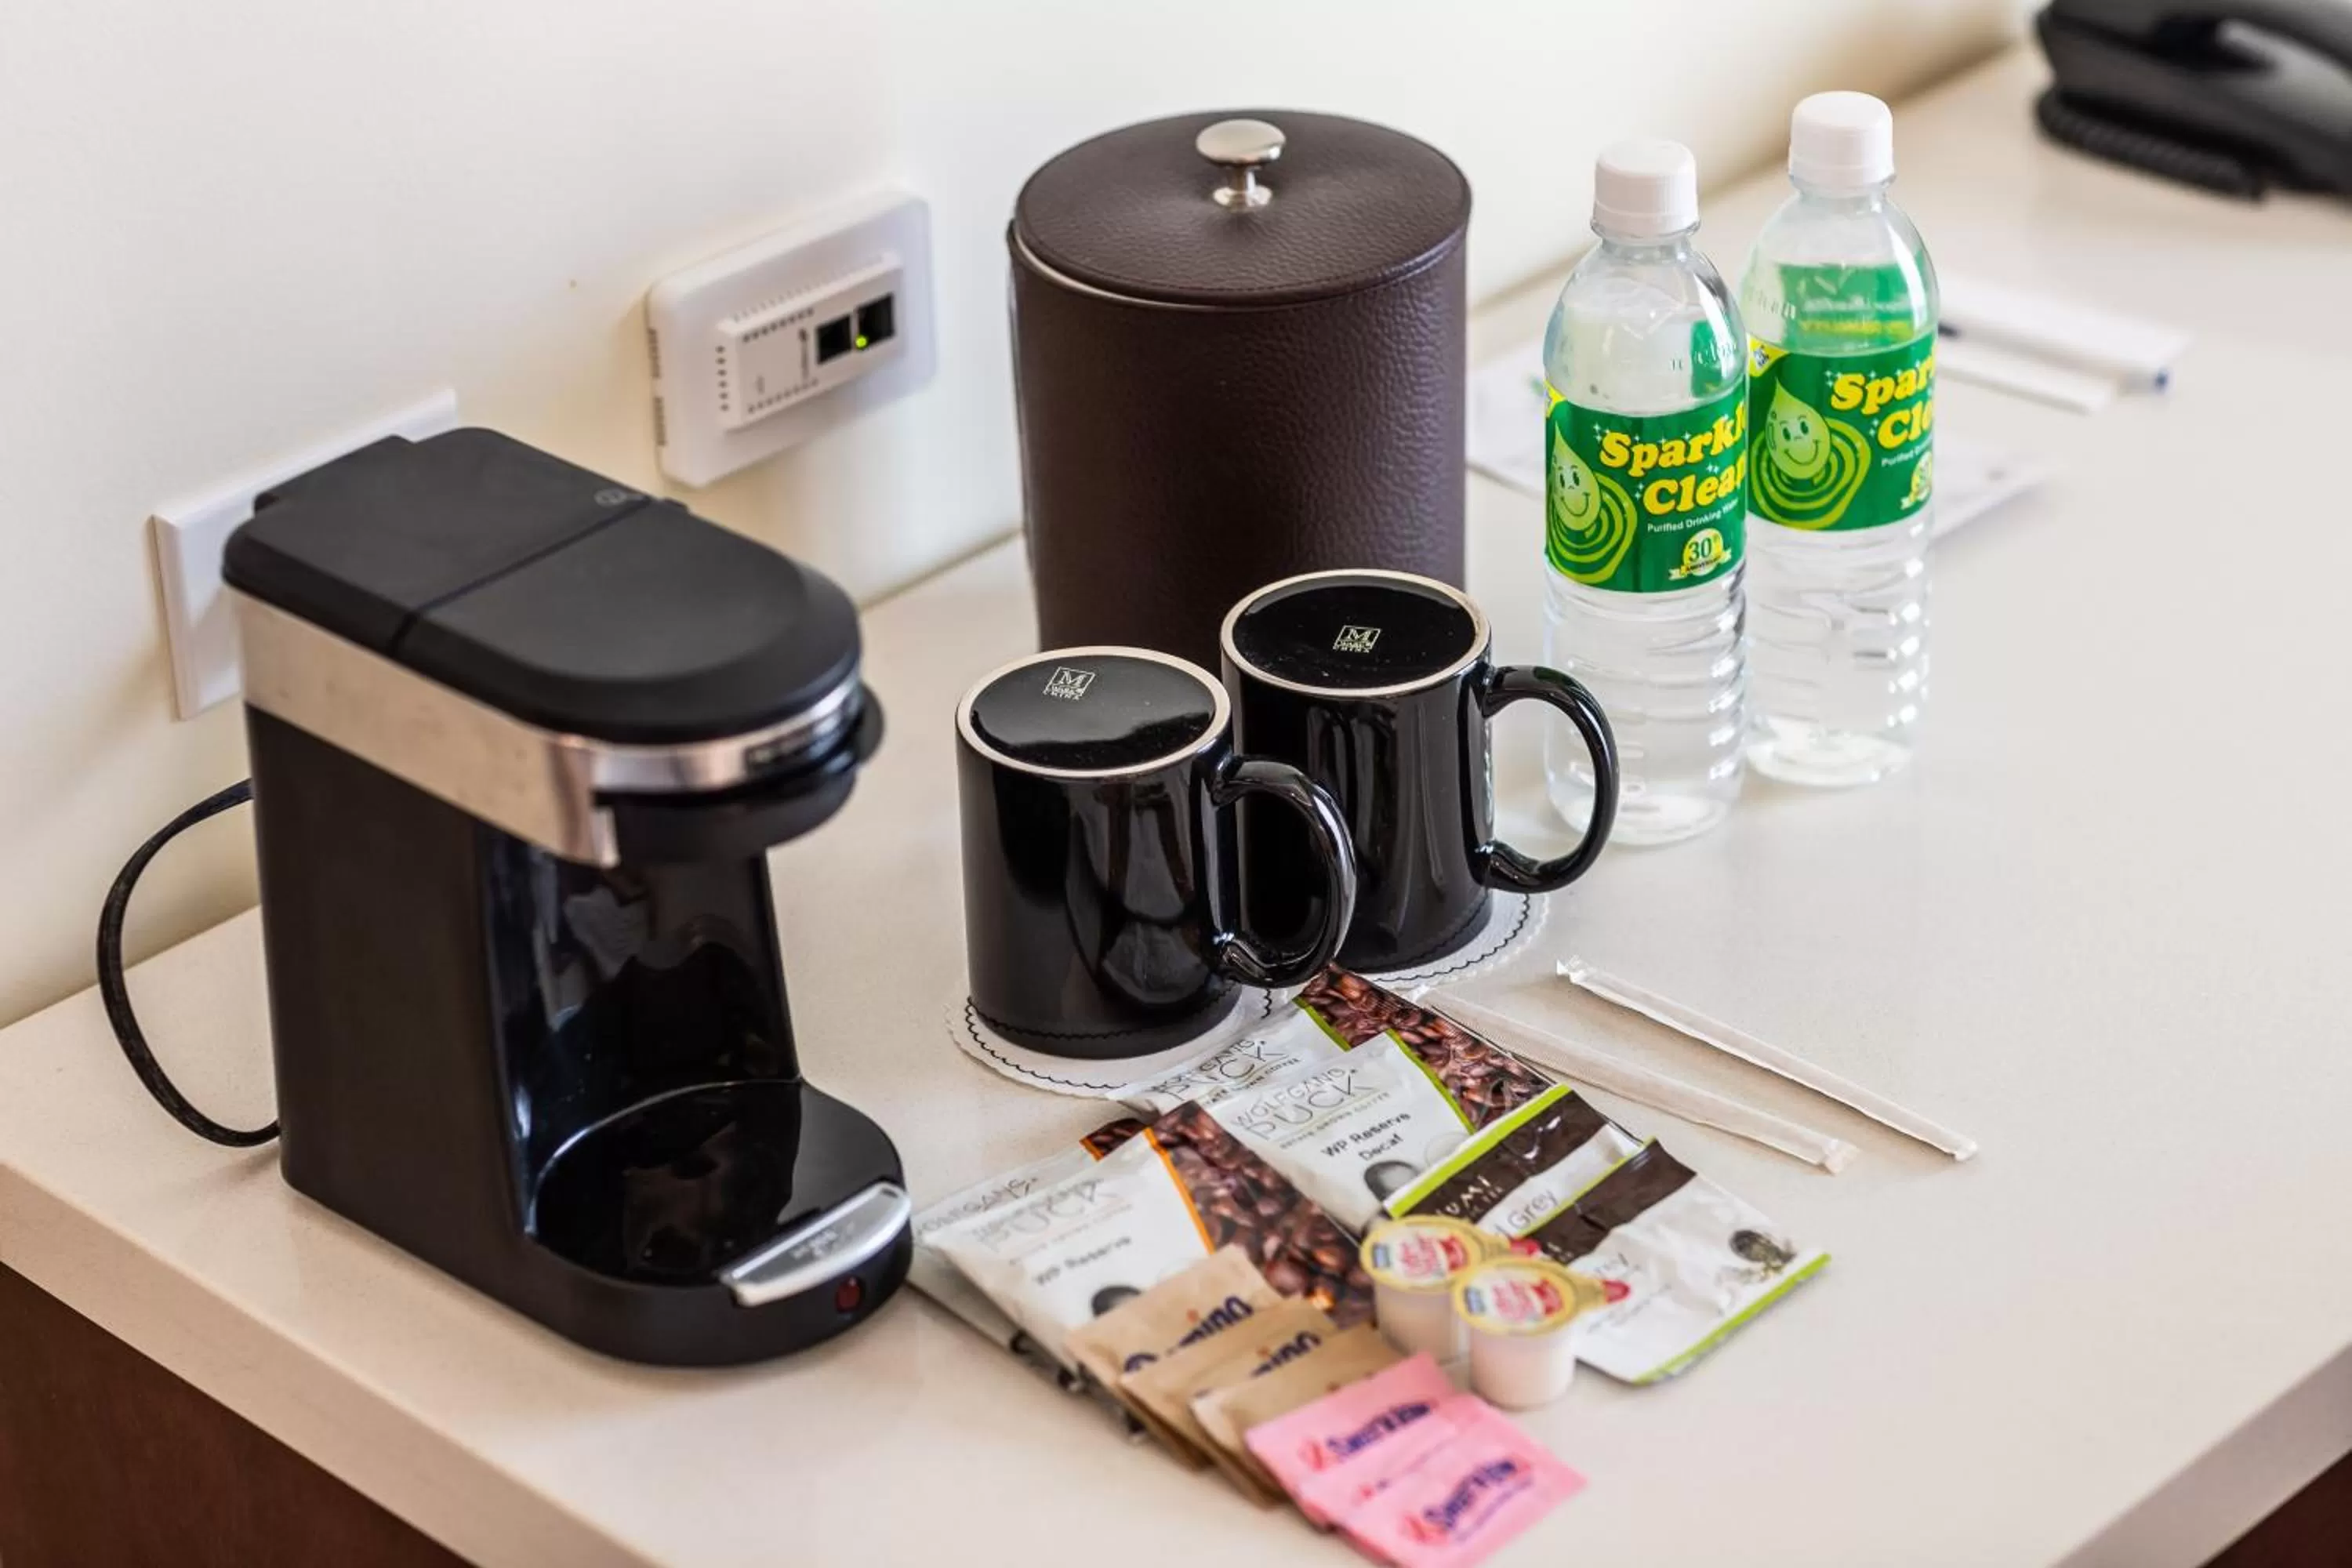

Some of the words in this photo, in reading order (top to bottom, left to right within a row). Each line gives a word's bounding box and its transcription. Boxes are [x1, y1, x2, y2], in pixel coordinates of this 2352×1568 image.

[1647, 519, 1684, 532] Purified
[1232, 1067, 1345, 1127] WOLFGANG
[1243, 1074, 1377, 1142] PUCK
[1321, 1138, 1348, 1157] WP
[1348, 1112, 1411, 1144] Reserve
[1359, 1133, 1405, 1161] Decaf
[1436, 1174, 1491, 1215] UMI
[1506, 1189, 1559, 1230] Grey
